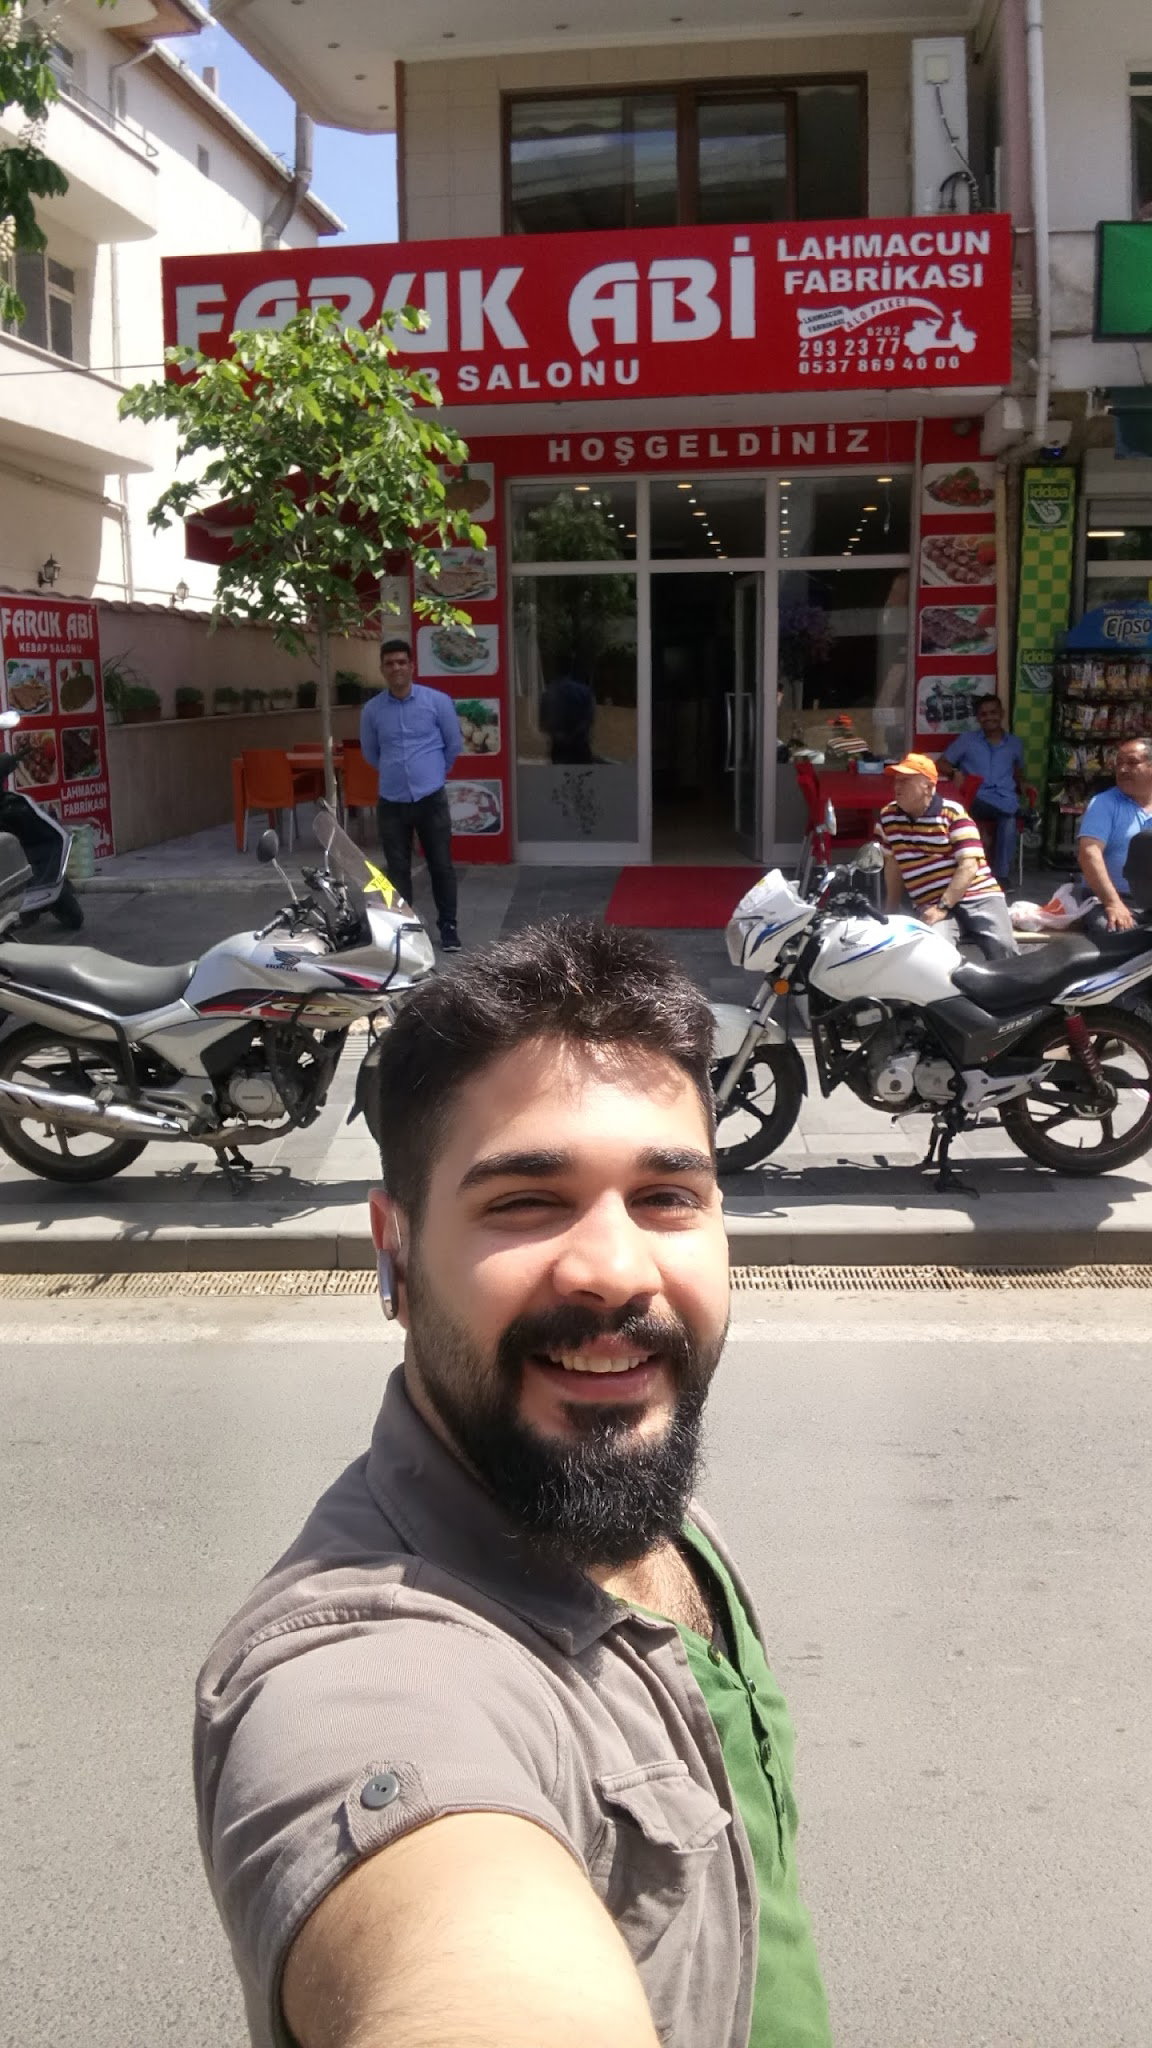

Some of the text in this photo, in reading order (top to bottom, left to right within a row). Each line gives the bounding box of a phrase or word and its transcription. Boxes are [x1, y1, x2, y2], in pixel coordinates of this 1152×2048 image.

[777, 230, 991, 262] LAHMACUN
[784, 261, 984, 295] FABRİKASI
[176, 236, 756, 375] FARUK ABİ
[846, 297, 909, 329] ALO PAKET
[799, 335, 900, 358] 293 23 77
[457, 359, 641, 392] SALONU
[798, 359, 850, 375] 0537
[548, 424, 871, 467] HOŞGELDİNİZ
[1, 608, 94, 642] FARUK ABİ
[1023, 650, 1054, 664] idda
[61, 783, 108, 800] LAHMACUN
[63, 797, 108, 817] FABRİKASI
[265, 963, 298, 973] HONDA
